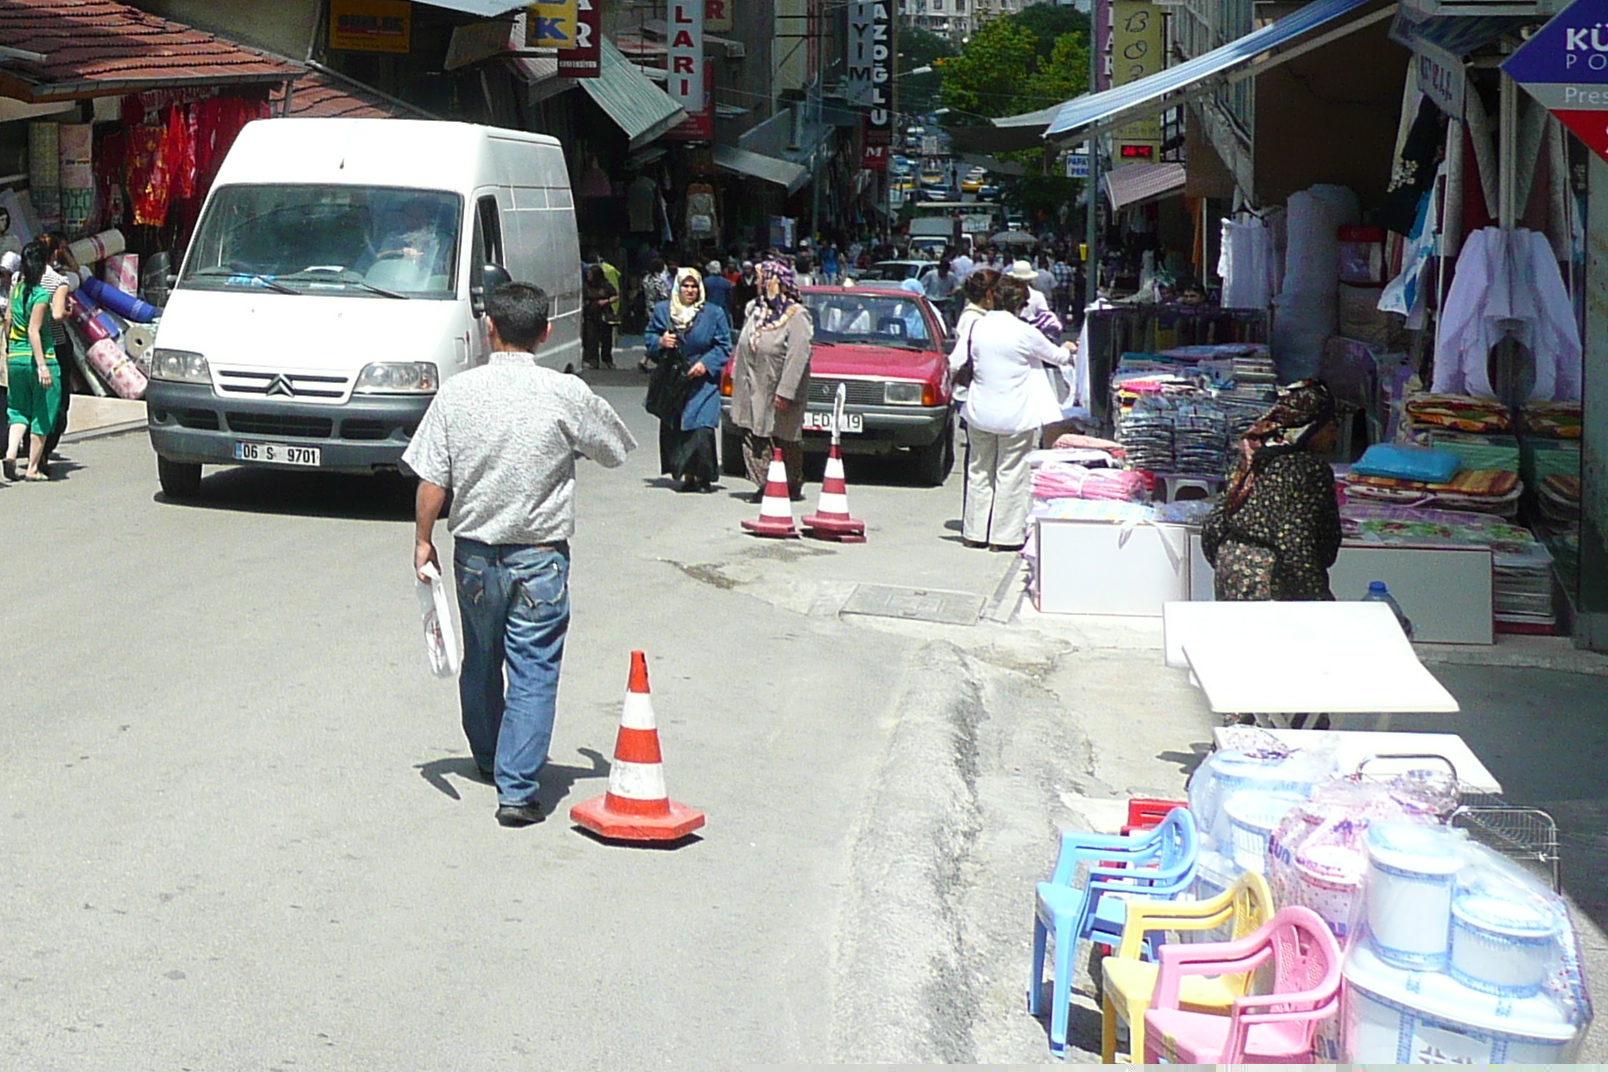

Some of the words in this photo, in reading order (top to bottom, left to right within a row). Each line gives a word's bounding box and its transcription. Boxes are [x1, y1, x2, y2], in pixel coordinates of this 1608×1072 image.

[243, 444, 258, 459] 06
[266, 446, 274, 460] S
[287, 448, 316, 464] 9701
